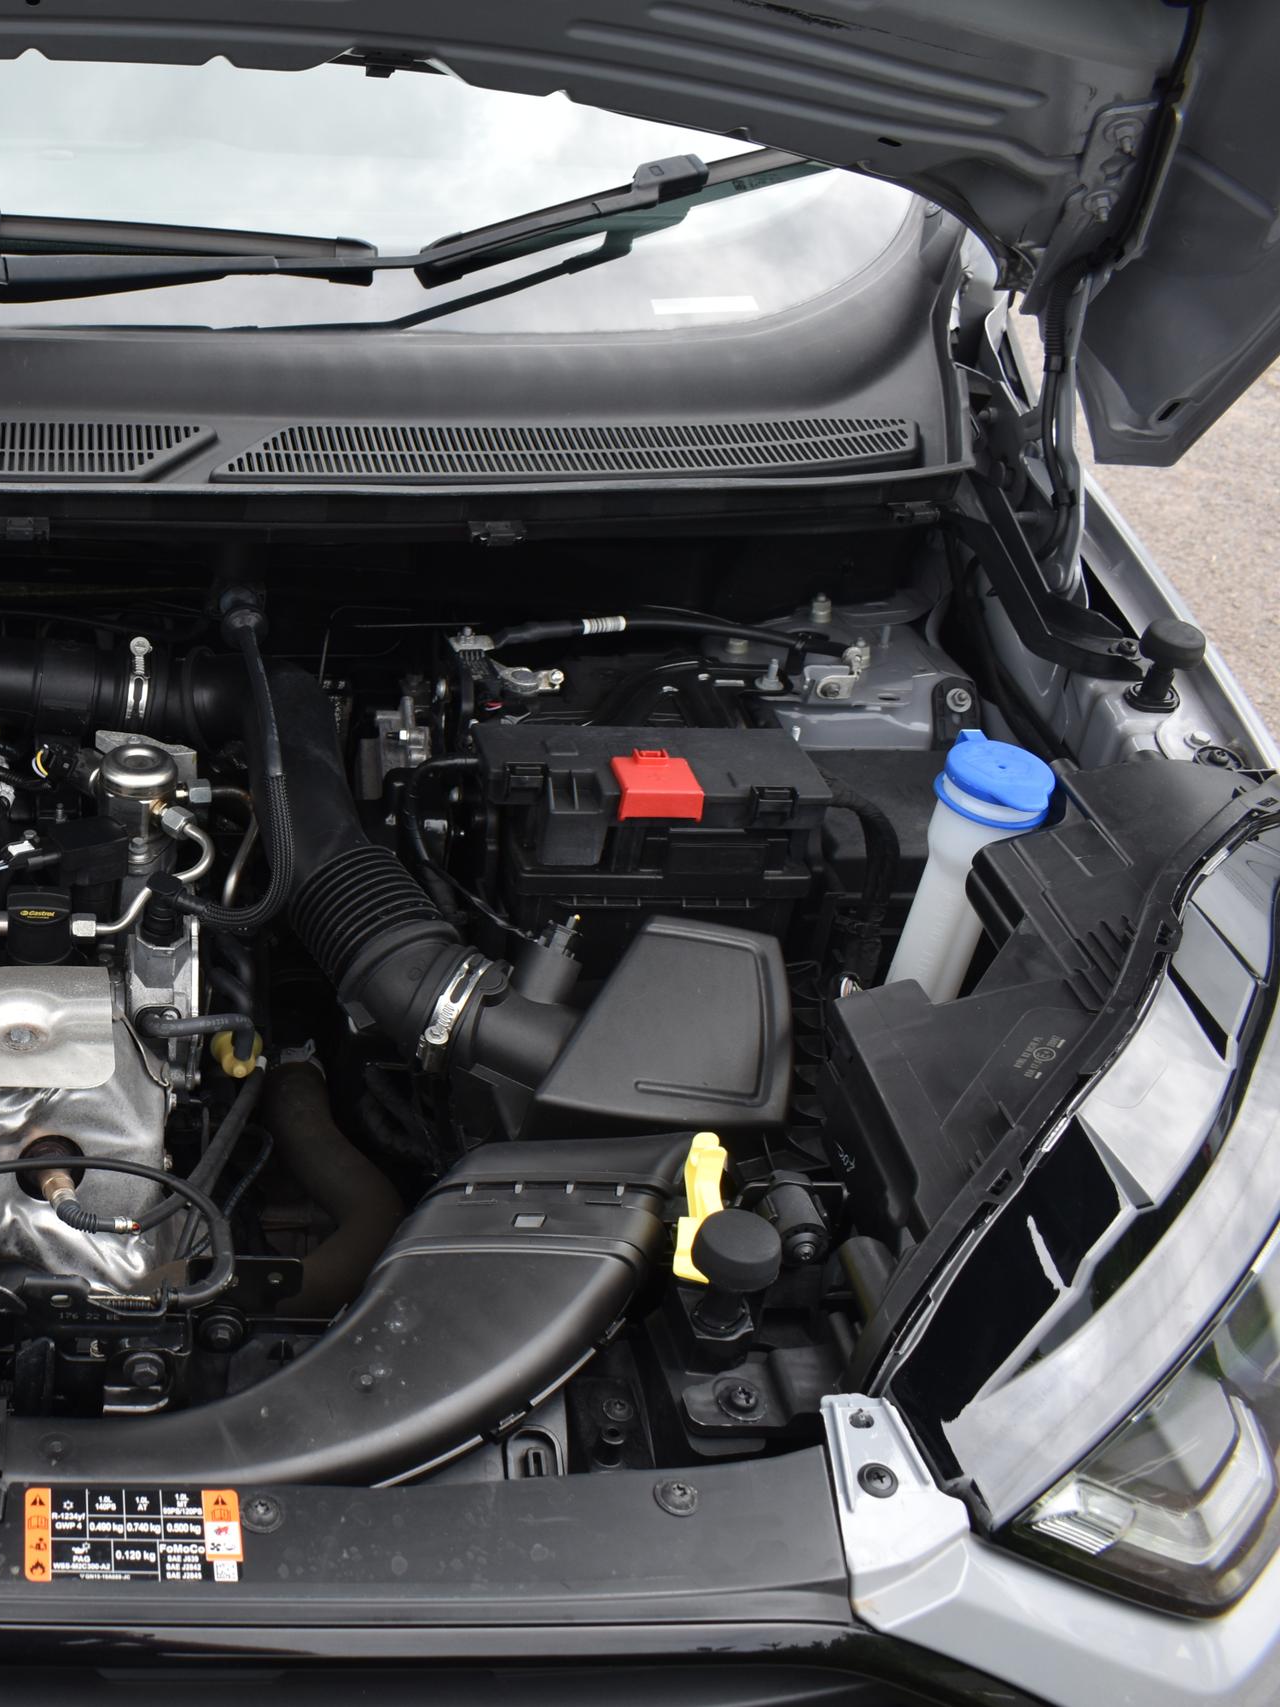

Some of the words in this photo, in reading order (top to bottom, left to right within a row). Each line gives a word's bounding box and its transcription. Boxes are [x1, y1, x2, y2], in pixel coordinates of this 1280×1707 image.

[51, 1512, 85, 1521] R-1234yf
[112, 1522, 123, 1534] kg
[127, 1522, 149, 1532] 0.740
[150, 1523, 161, 1534] kg
[190, 1523, 201, 1534] kg
[160, 1544, 205, 1554] FoMoCo
[115, 1550, 142, 1560] 0.120
[143, 1550, 156, 1562] kg
